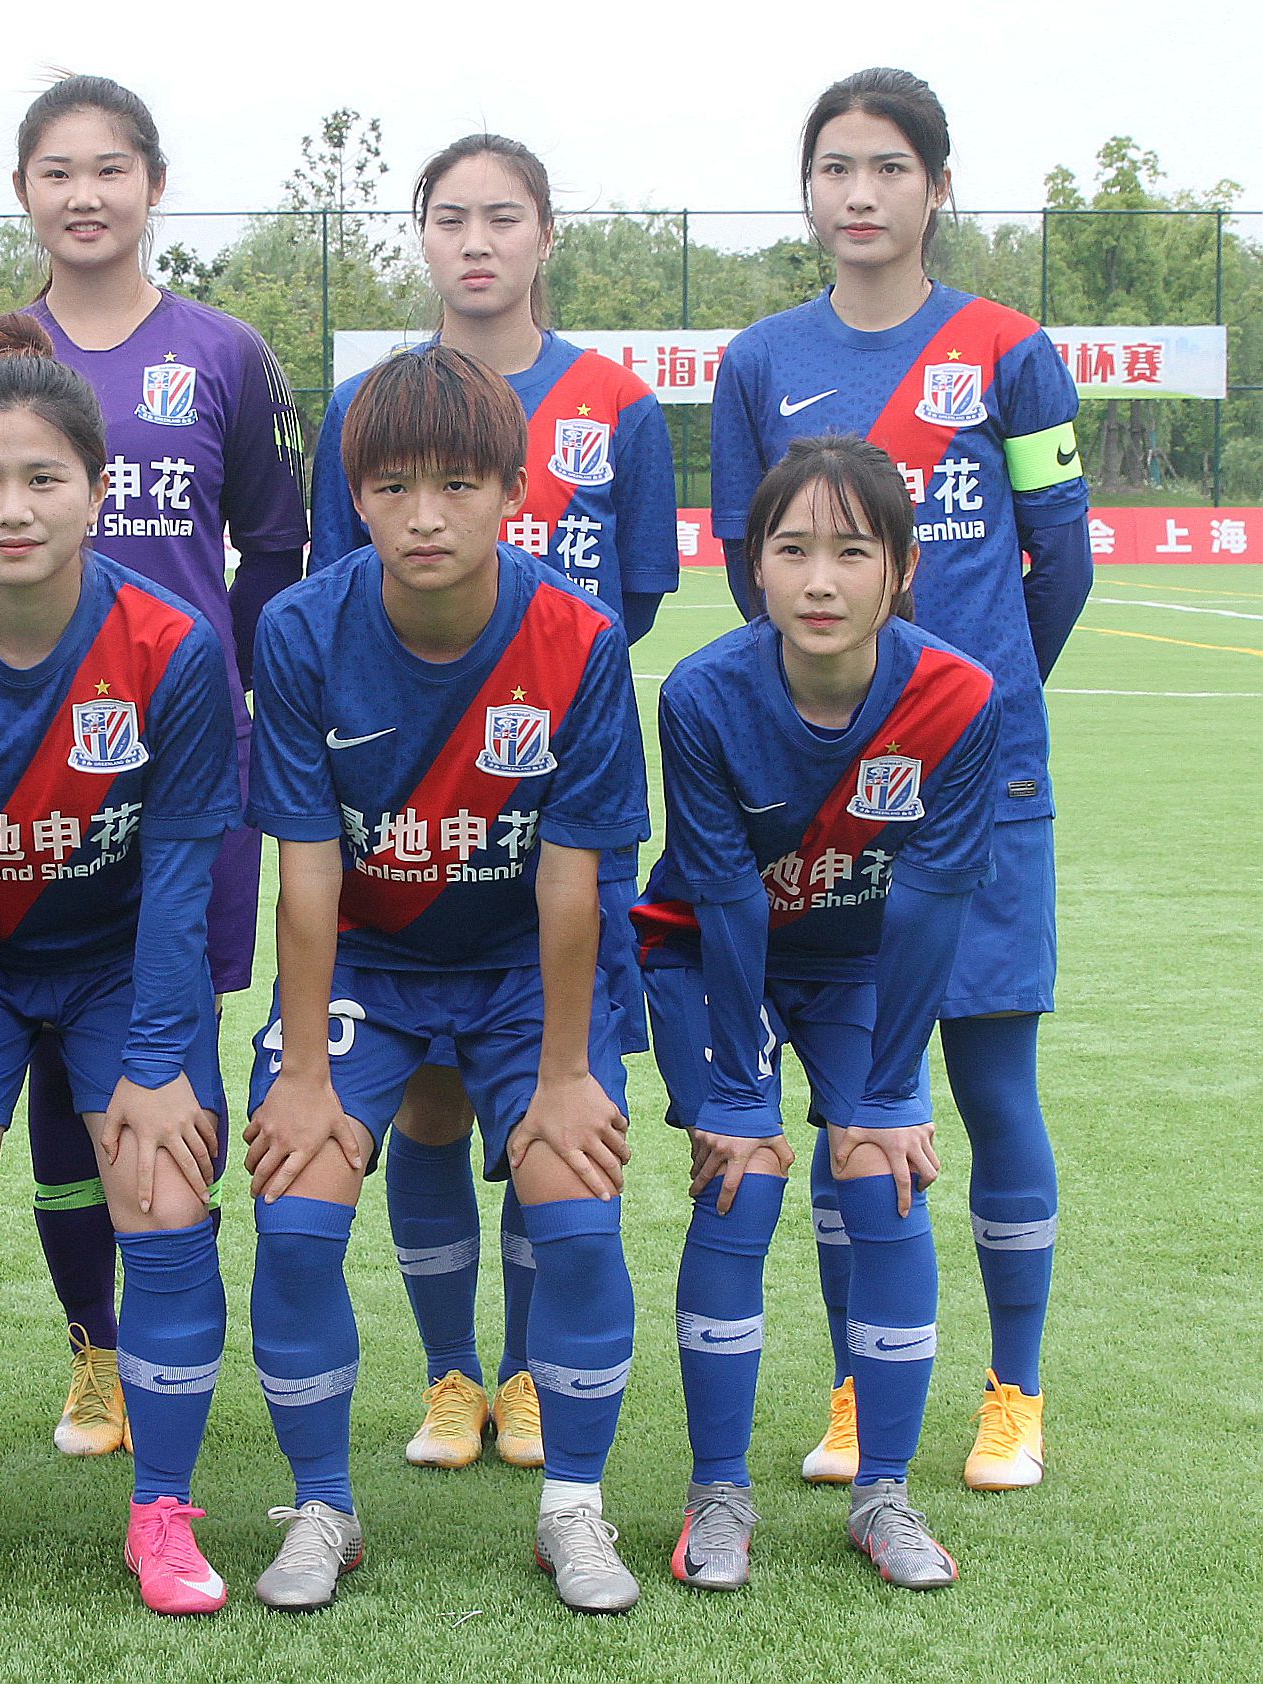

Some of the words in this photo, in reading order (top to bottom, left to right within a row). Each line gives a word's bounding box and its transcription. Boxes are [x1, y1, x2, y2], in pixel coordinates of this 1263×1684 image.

[104, 454, 196, 511] 申花
[104, 513, 194, 538] Shenhua
[912, 517, 986, 543] enhua
[40, 842, 131, 882] Shenhu
[353, 853, 438, 883] enland
